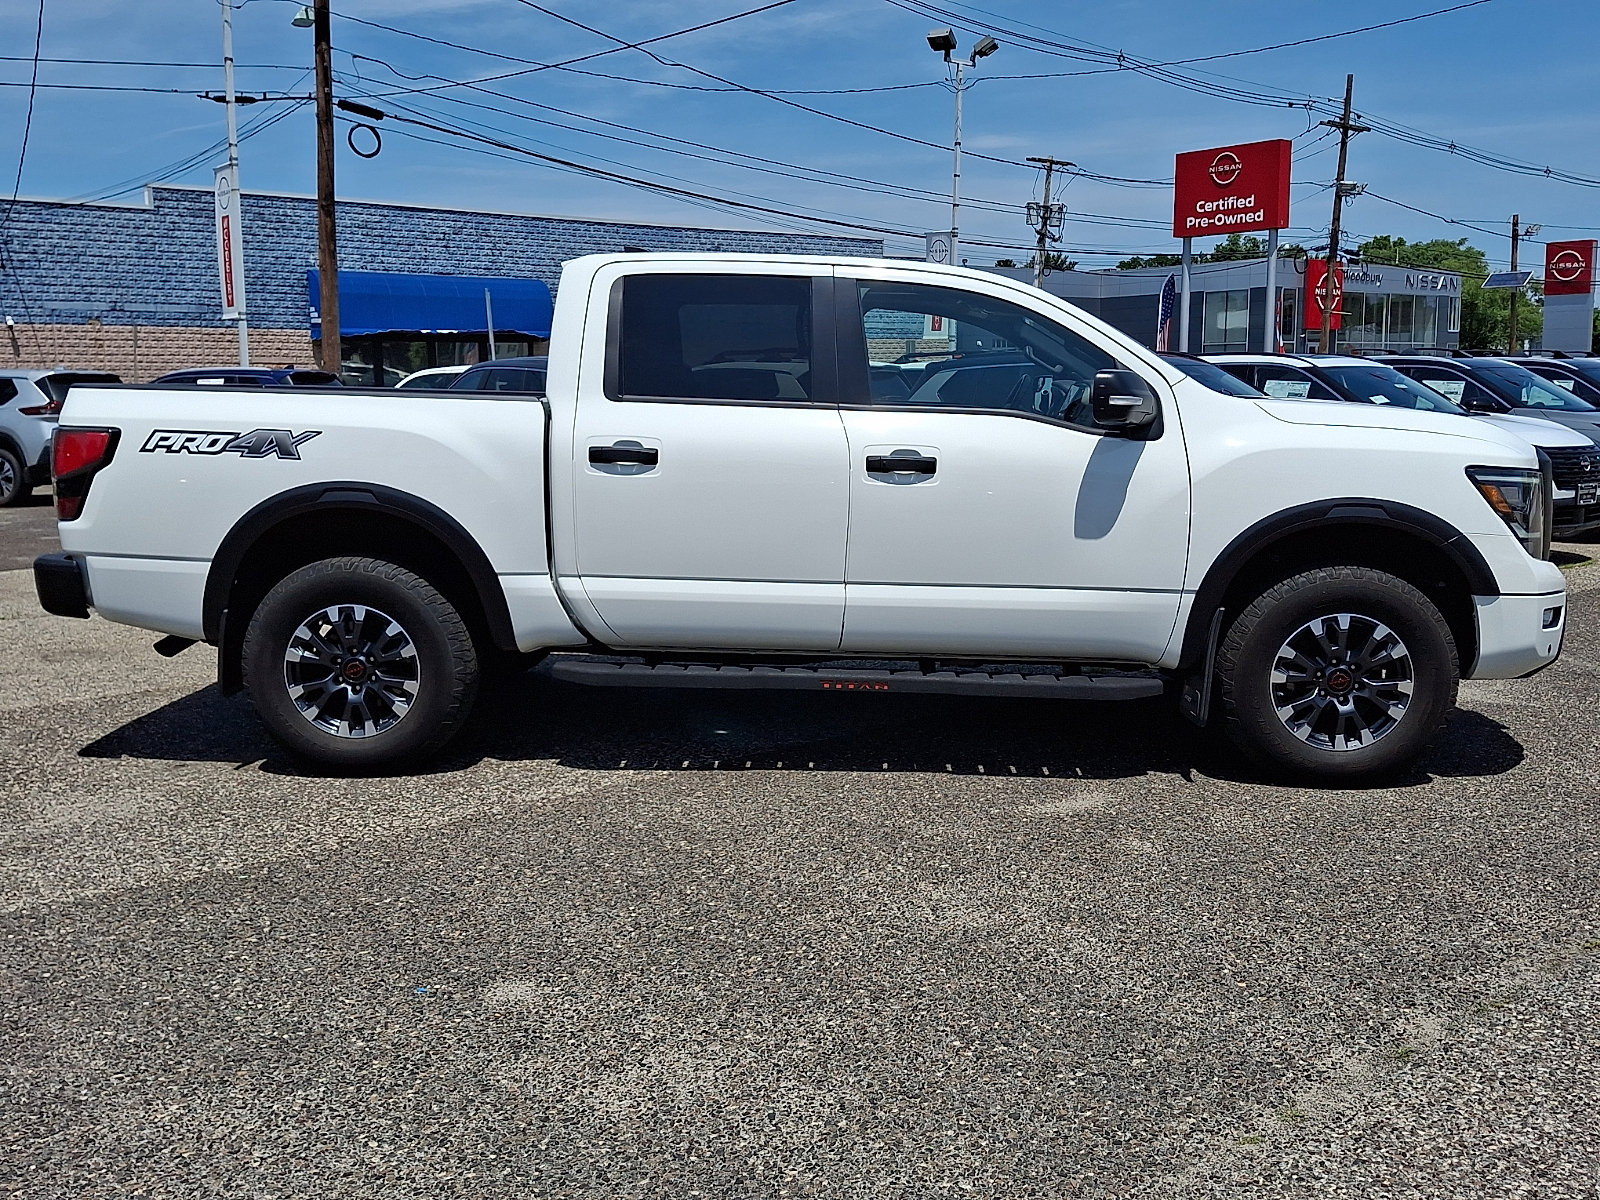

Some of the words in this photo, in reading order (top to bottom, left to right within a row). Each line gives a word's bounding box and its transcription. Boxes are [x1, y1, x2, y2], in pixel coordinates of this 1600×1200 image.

[1209, 163, 1242, 173] NISSAN
[1196, 194, 1255, 213] Certified
[1186, 209, 1264, 229] Pre-Owned
[1405, 273, 1458, 290] NISSAN
[1315, 287, 1341, 296] NISAN
